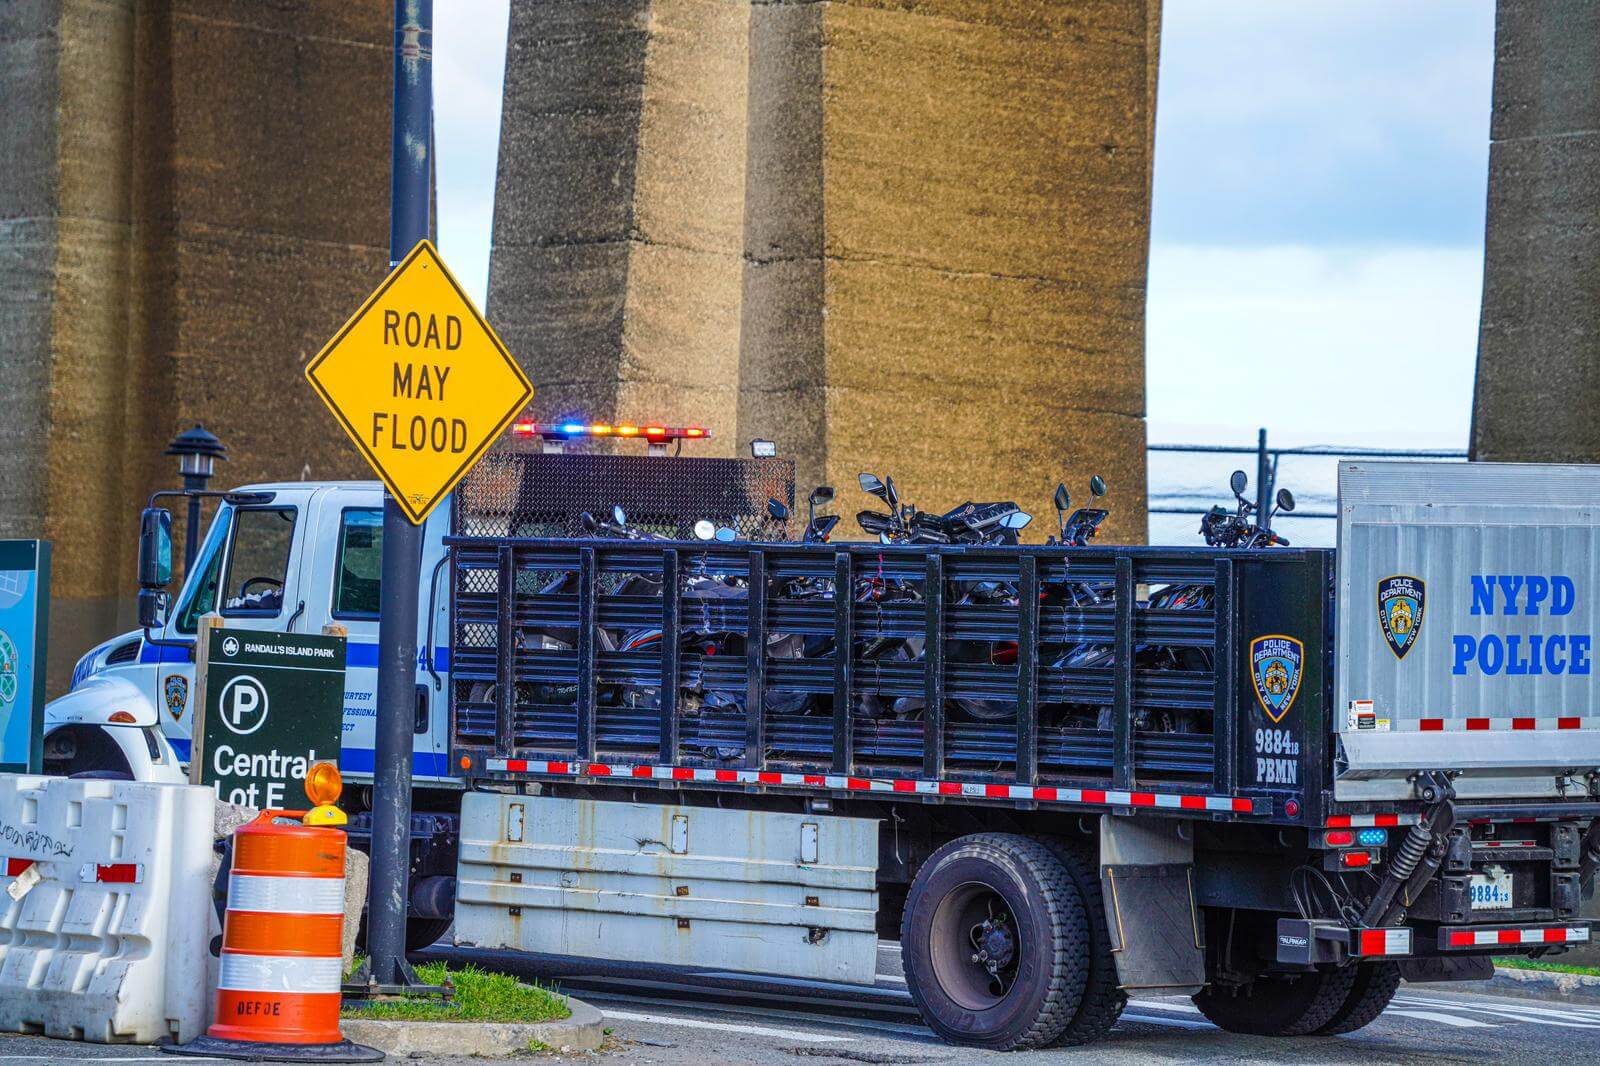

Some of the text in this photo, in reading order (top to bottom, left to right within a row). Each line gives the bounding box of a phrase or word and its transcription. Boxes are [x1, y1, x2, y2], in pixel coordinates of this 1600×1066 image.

[384, 310, 462, 350] ROAD
[393, 362, 450, 400] MAY
[372, 412, 467, 454] FLOOD
[1380, 587, 1422, 601] DEPARTMENT
[1390, 578, 1414, 588] POLICE
[1471, 575, 1575, 615] NYPD
[1380, 609, 1389, 629] CITY
[244, 643, 335, 658] RANDALL'S ISLAND PARK
[1263, 639, 1292, 651] POLICE
[1407, 629, 1417, 646] NEW
[1254, 648, 1300, 664] DEPARTMENT
[1453, 634, 1591, 675] POLICE
[344, 691, 373, 701] URTESY
[1254, 672, 1272, 706] CITY OF
[1280, 668, 1300, 711] NEW YORK
[233, 684, 259, 725] P
[1256, 757, 1298, 784] PBMN
[266, 783, 286, 810] E
